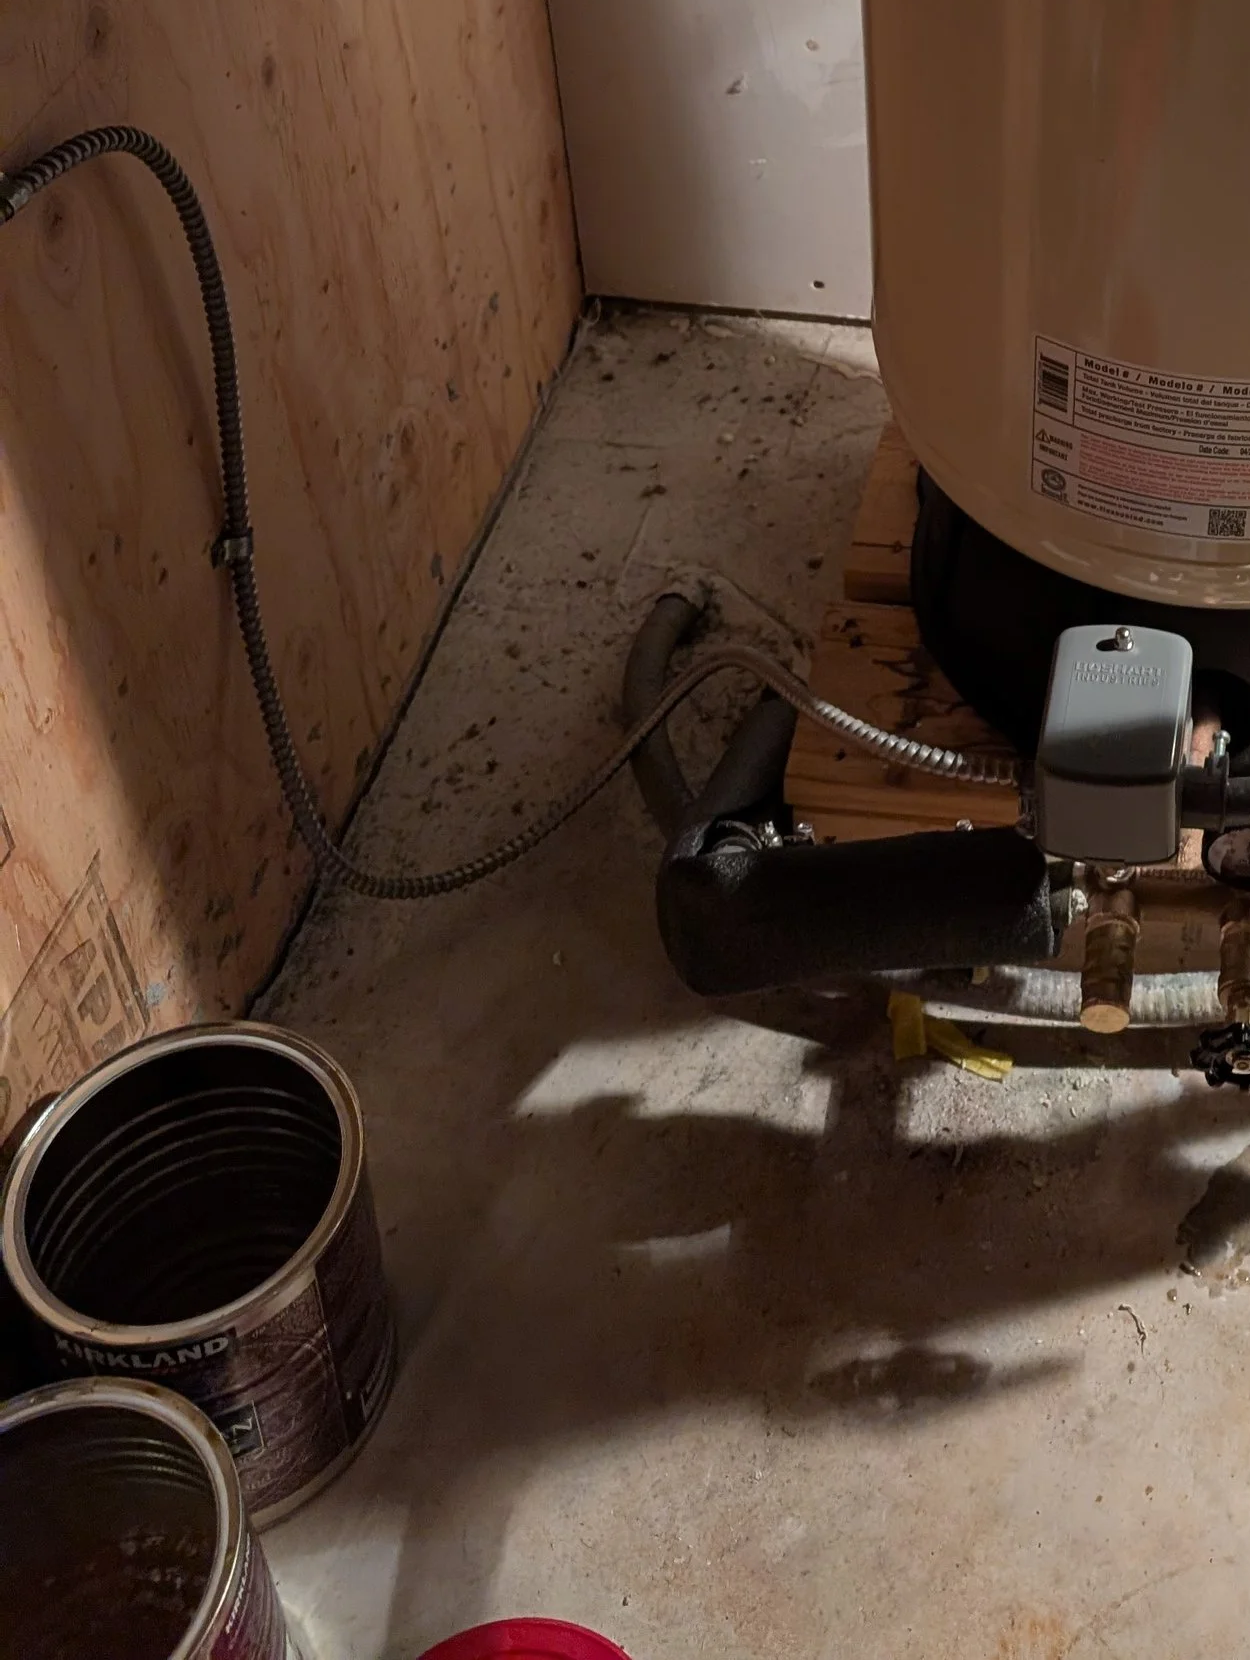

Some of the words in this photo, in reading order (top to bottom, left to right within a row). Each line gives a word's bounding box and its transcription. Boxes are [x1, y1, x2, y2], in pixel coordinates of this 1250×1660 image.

[1084, 357, 1120, 377] Model
[1135, 372, 1142, 382] /
[1148, 375, 1194, 391] Modelo
[1196, 384, 1204, 392] #
[1208, 384, 1216, 394] /
[1082, 372, 1099, 384] Total
[1100, 378, 1117, 389] Tank
[1117, 381, 1144, 396] Volume
[1150, 391, 1181, 404] Volumen
[1182, 395, 1200, 405] total
[1200, 398, 1213, 407] del
[1214, 400, 1240, 410] tanque
[1082, 385, 1099, 398] Max.
[1100, 391, 1146, 408] Working/Test
[1146, 402, 1180, 415] Pressure
[1134, 421, 1151, 430] from
[1151, 424, 1177, 437] factory
[1216, 432, 1226, 440] de
[1199, 445, 1212, 455] Date
[1074, 672, 1160, 686] INDUSTRIES
[55, 1334, 230, 1369] KIRKLAND
